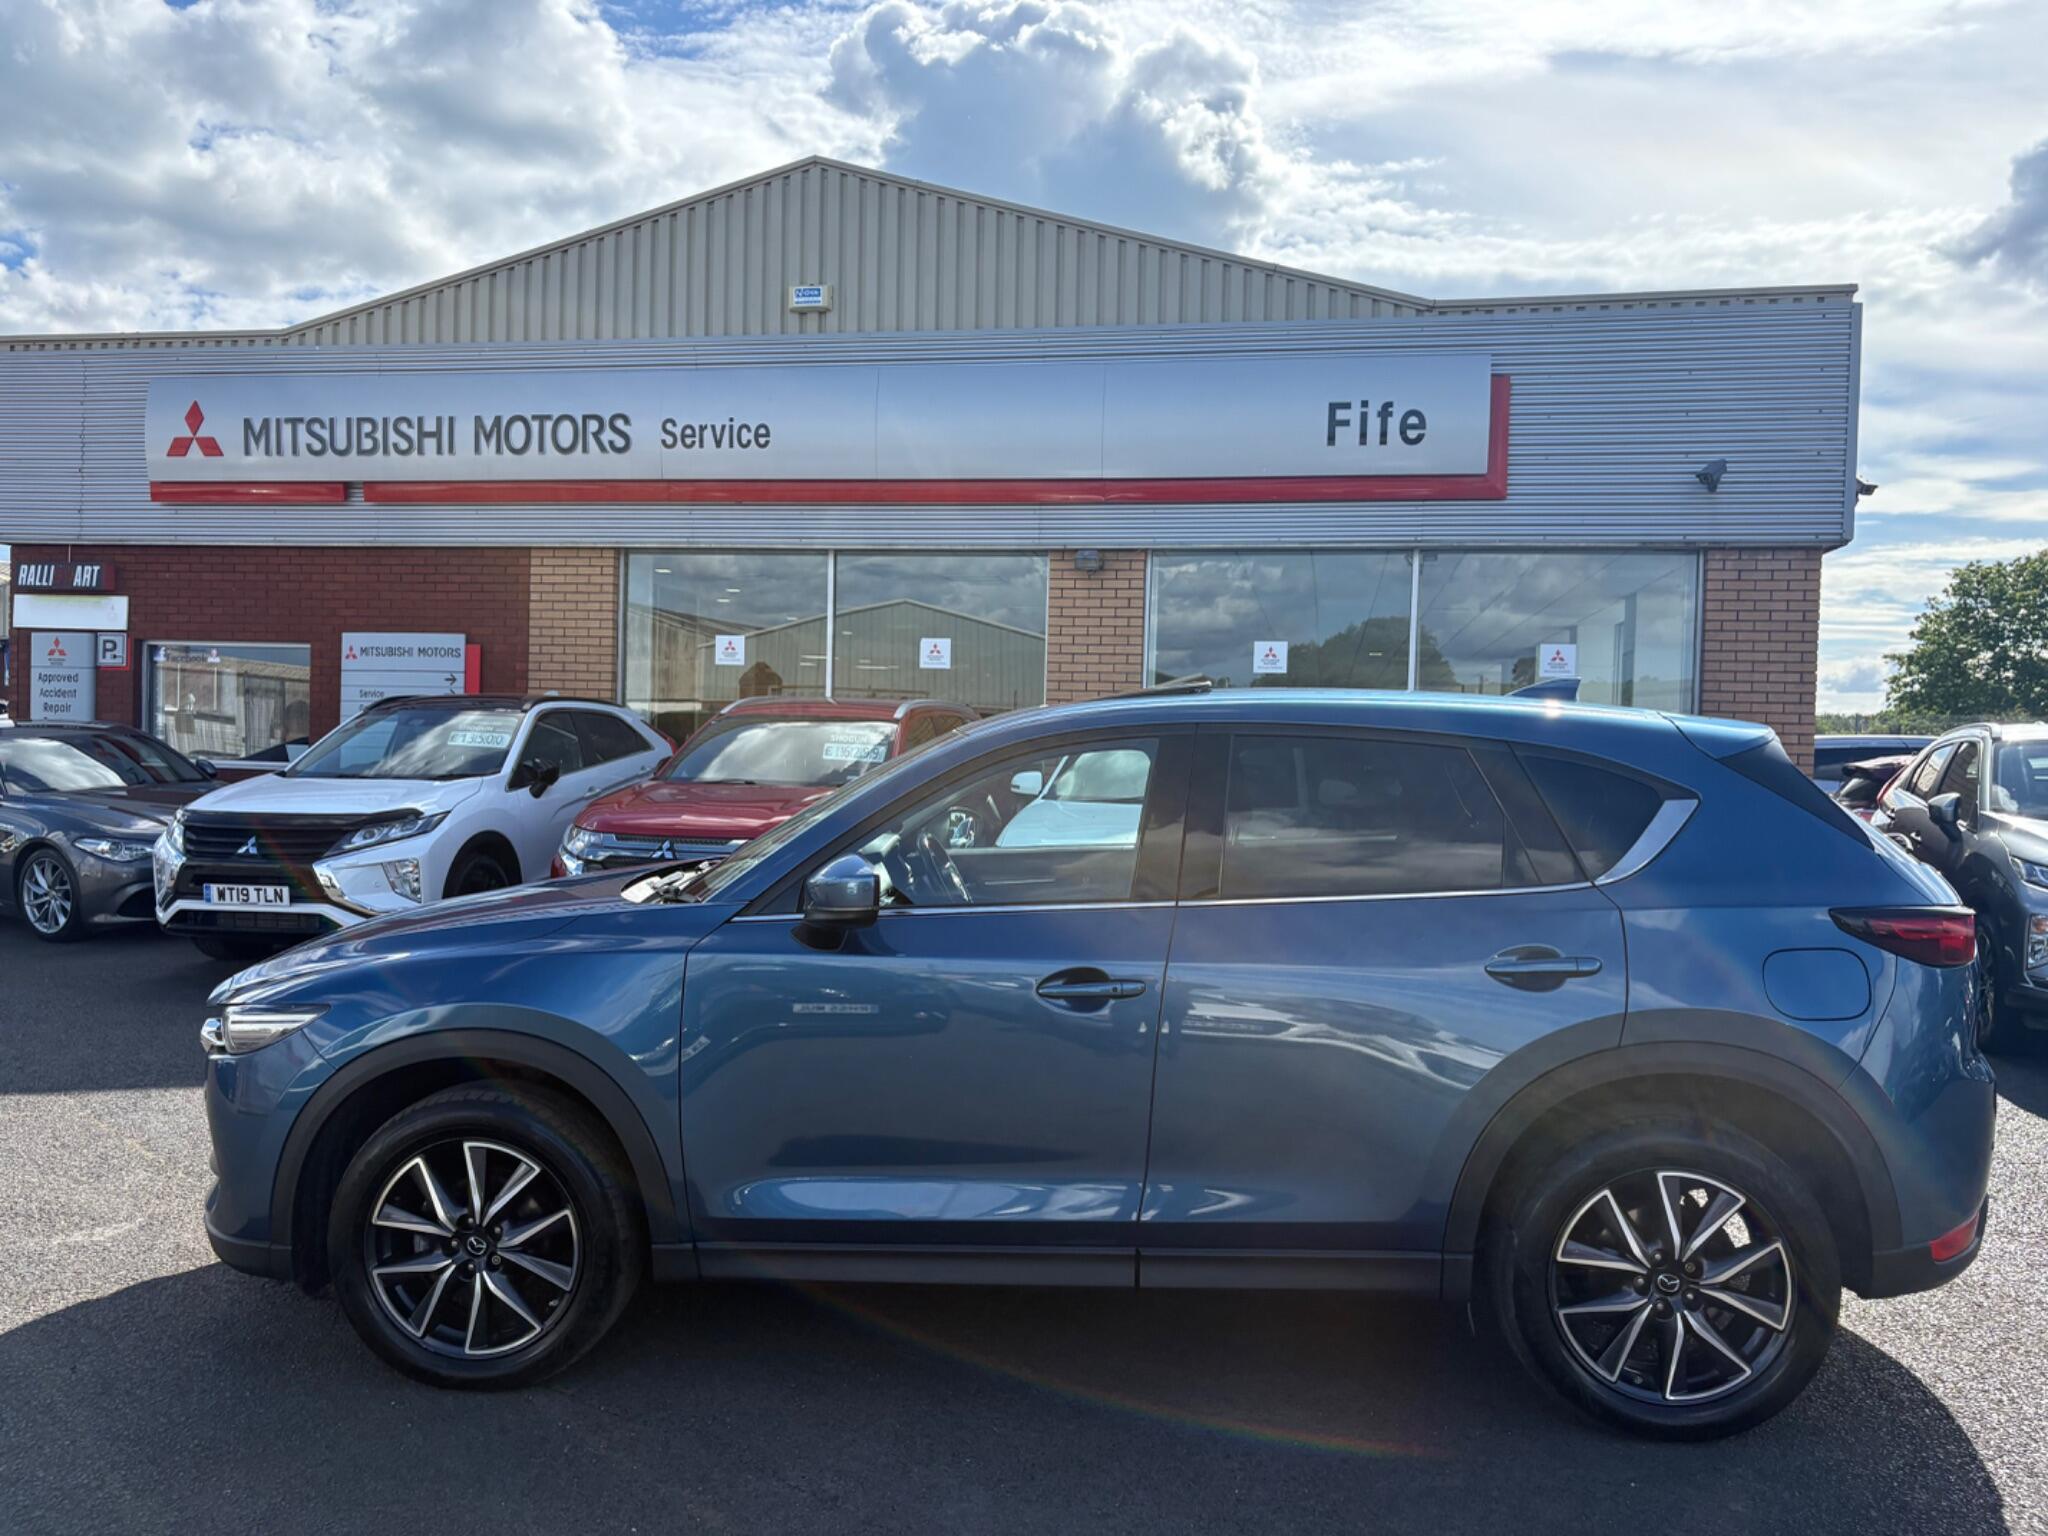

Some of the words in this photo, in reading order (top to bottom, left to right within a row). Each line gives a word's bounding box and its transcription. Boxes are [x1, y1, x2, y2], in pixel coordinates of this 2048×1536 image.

[1327, 400, 1427, 446] Fife
[243, 415, 456, 457] MITSUBISHI
[474, 413, 632, 456] MOTORS
[660, 417, 771, 449] Service
[18, 564, 55, 587] RALLI
[72, 565, 100, 588] ART
[102, 640, 117, 659] P
[360, 646, 413, 657] MITSUBISHI
[418, 647, 462, 658] MOTORS
[38, 672, 79, 684] Approved
[39, 688, 77, 699] Accident
[359, 688, 385, 698] Service
[43, 702, 72, 714] Repair
[217, 886, 250, 902] WT19
[254, 888, 284, 903] TLN
